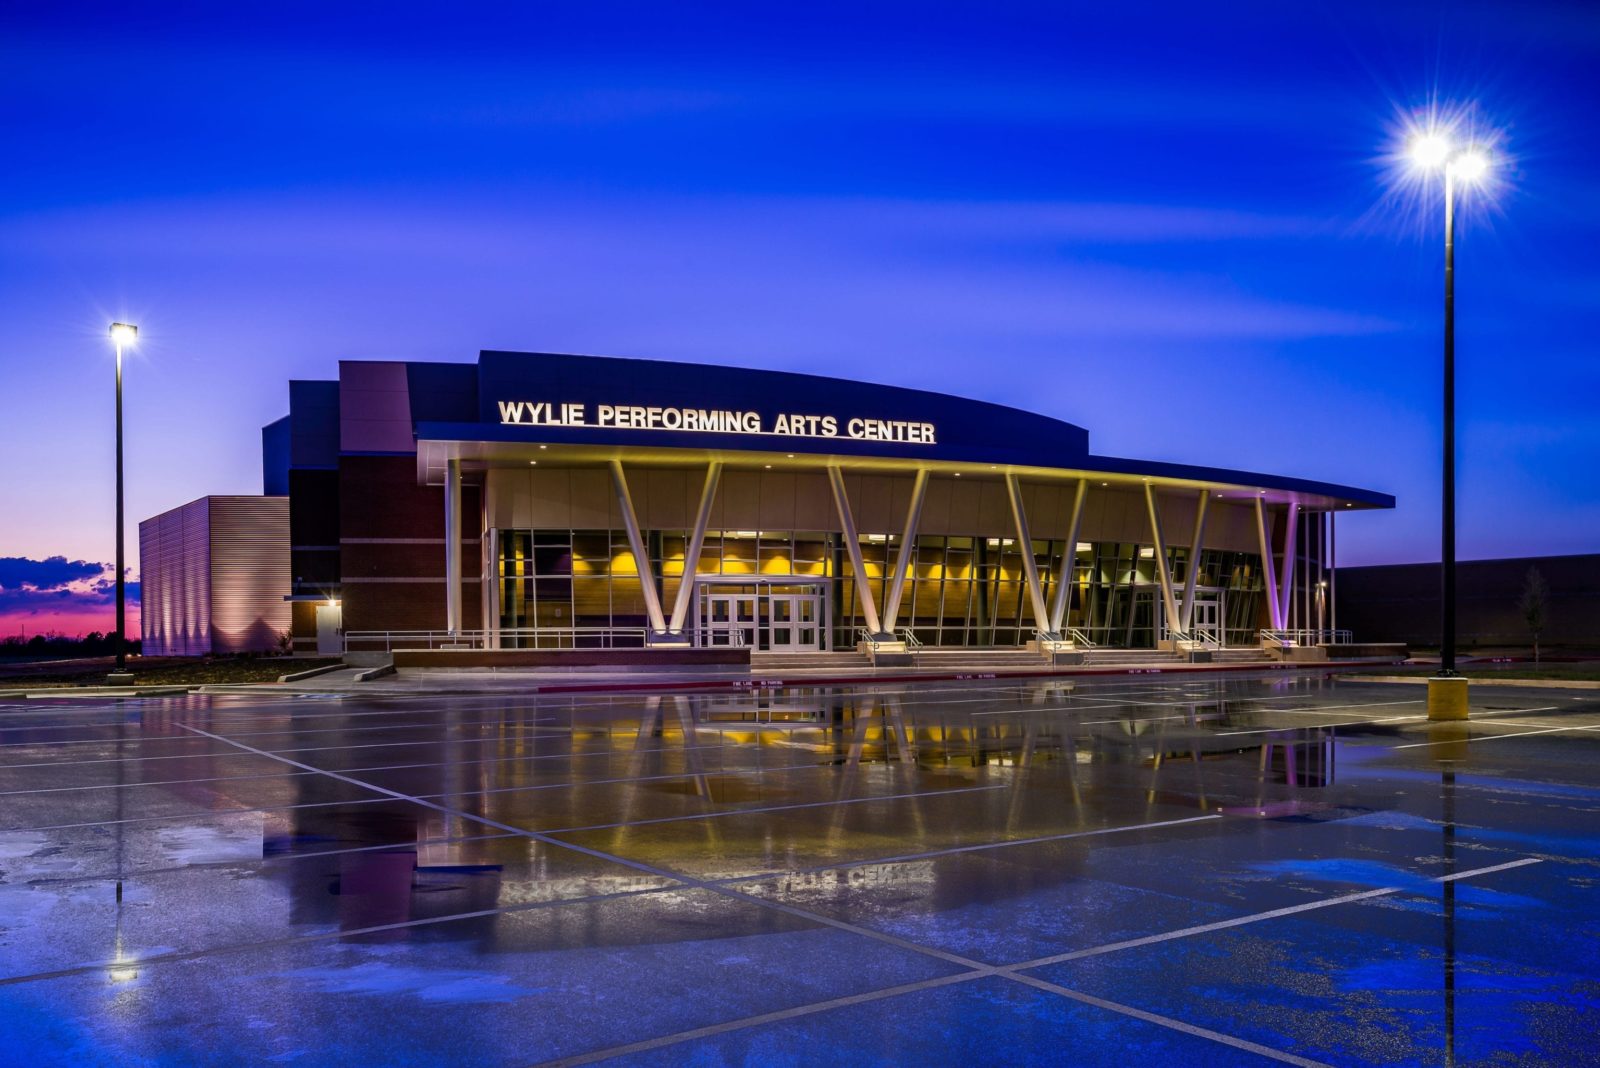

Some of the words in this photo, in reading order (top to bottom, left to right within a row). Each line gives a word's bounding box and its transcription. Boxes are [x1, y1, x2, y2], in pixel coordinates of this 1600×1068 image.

[498, 401, 585, 425] WYLIE
[598, 405, 760, 433] PERFORMING
[774, 414, 838, 437] ARTS
[847, 418, 935, 443] CENTER
